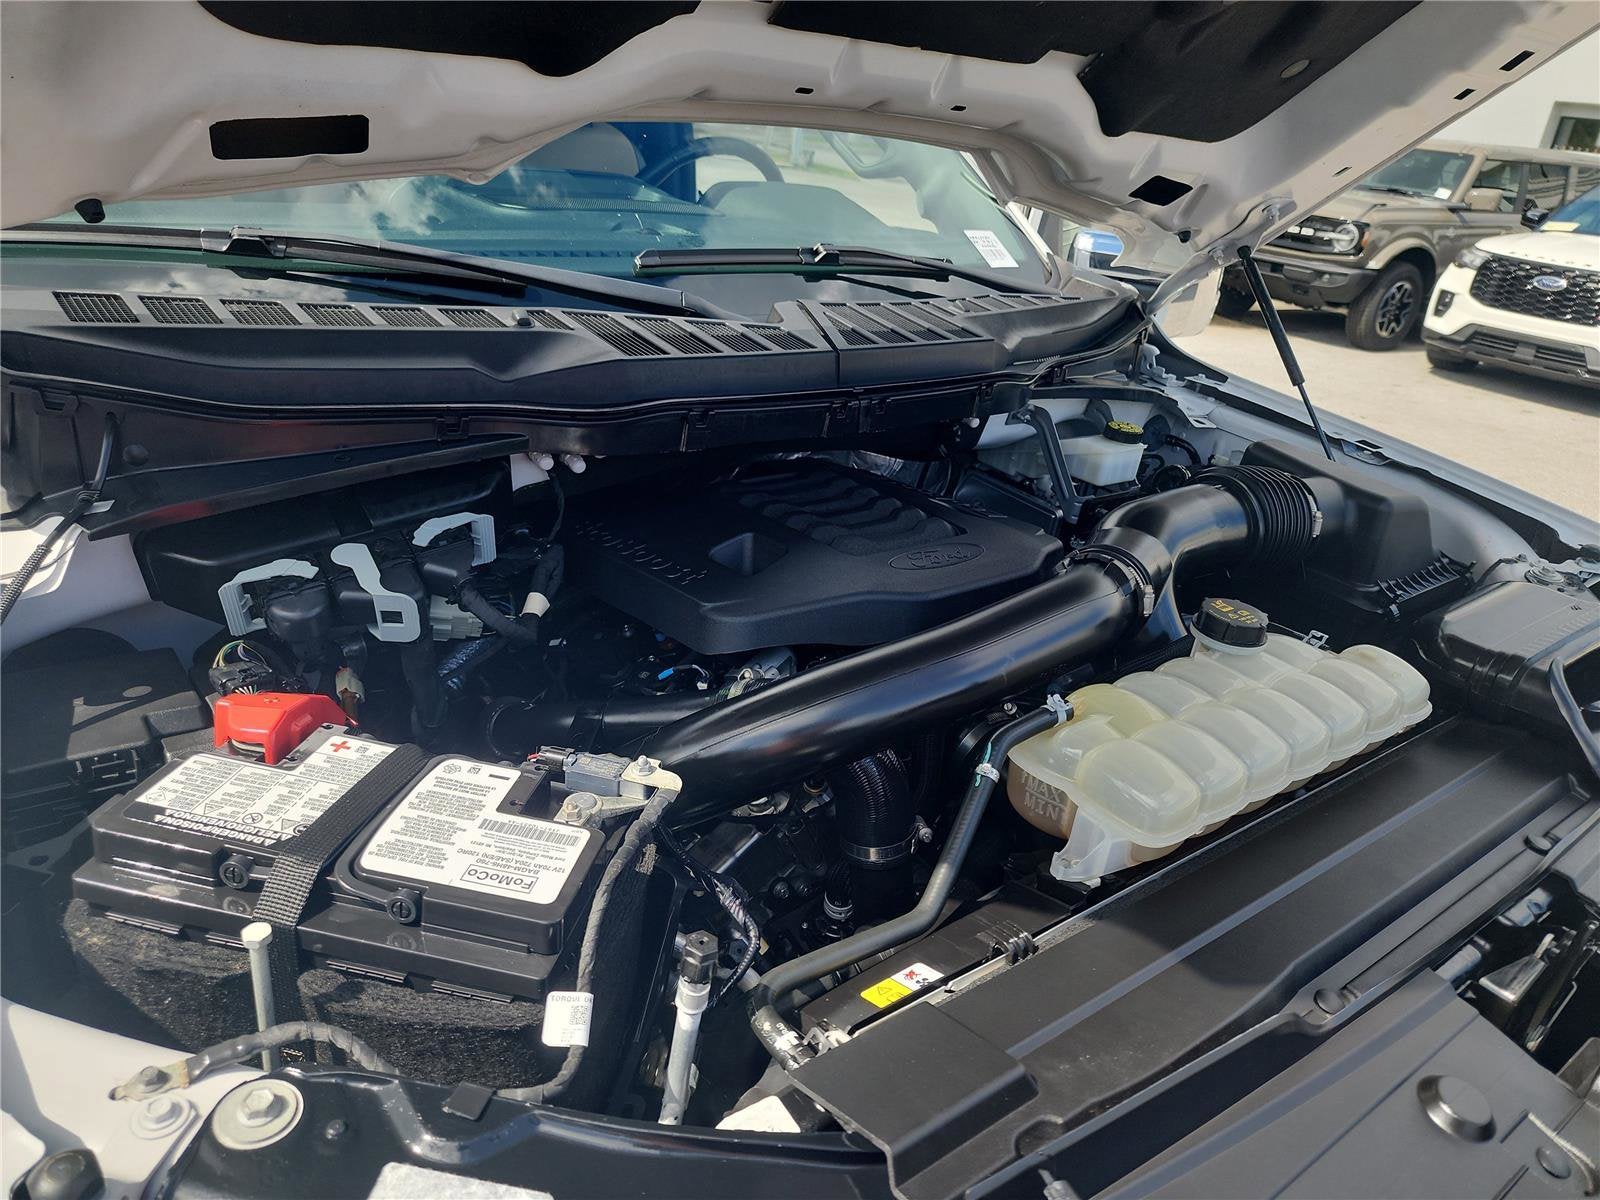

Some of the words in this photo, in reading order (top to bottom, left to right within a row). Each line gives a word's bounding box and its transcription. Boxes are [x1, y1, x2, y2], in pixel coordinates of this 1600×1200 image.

[1024, 792, 1060, 821] MIN
[162, 815, 264, 844] DANGER/POISON
[174, 810, 282, 840] PELIGRO/VENENO
[468, 868, 534, 889] FoMoCo
